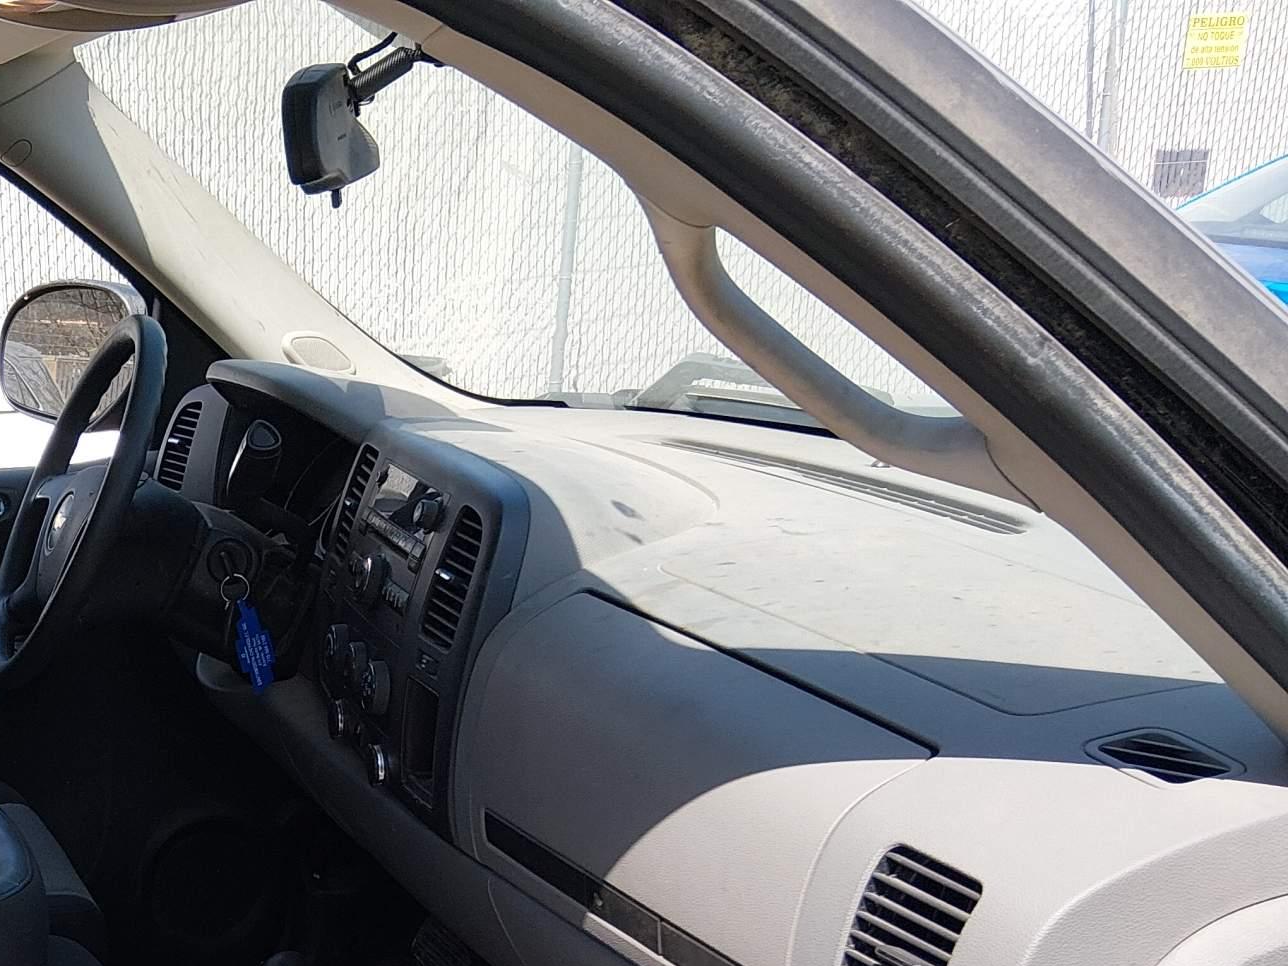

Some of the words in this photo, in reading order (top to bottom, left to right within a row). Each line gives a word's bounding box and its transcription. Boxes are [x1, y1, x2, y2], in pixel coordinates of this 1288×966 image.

[1192, 16, 1245, 27] PELIGRO
[1197, 31, 1208, 41] NO
[1211, 31, 1235, 40] TOQUE
